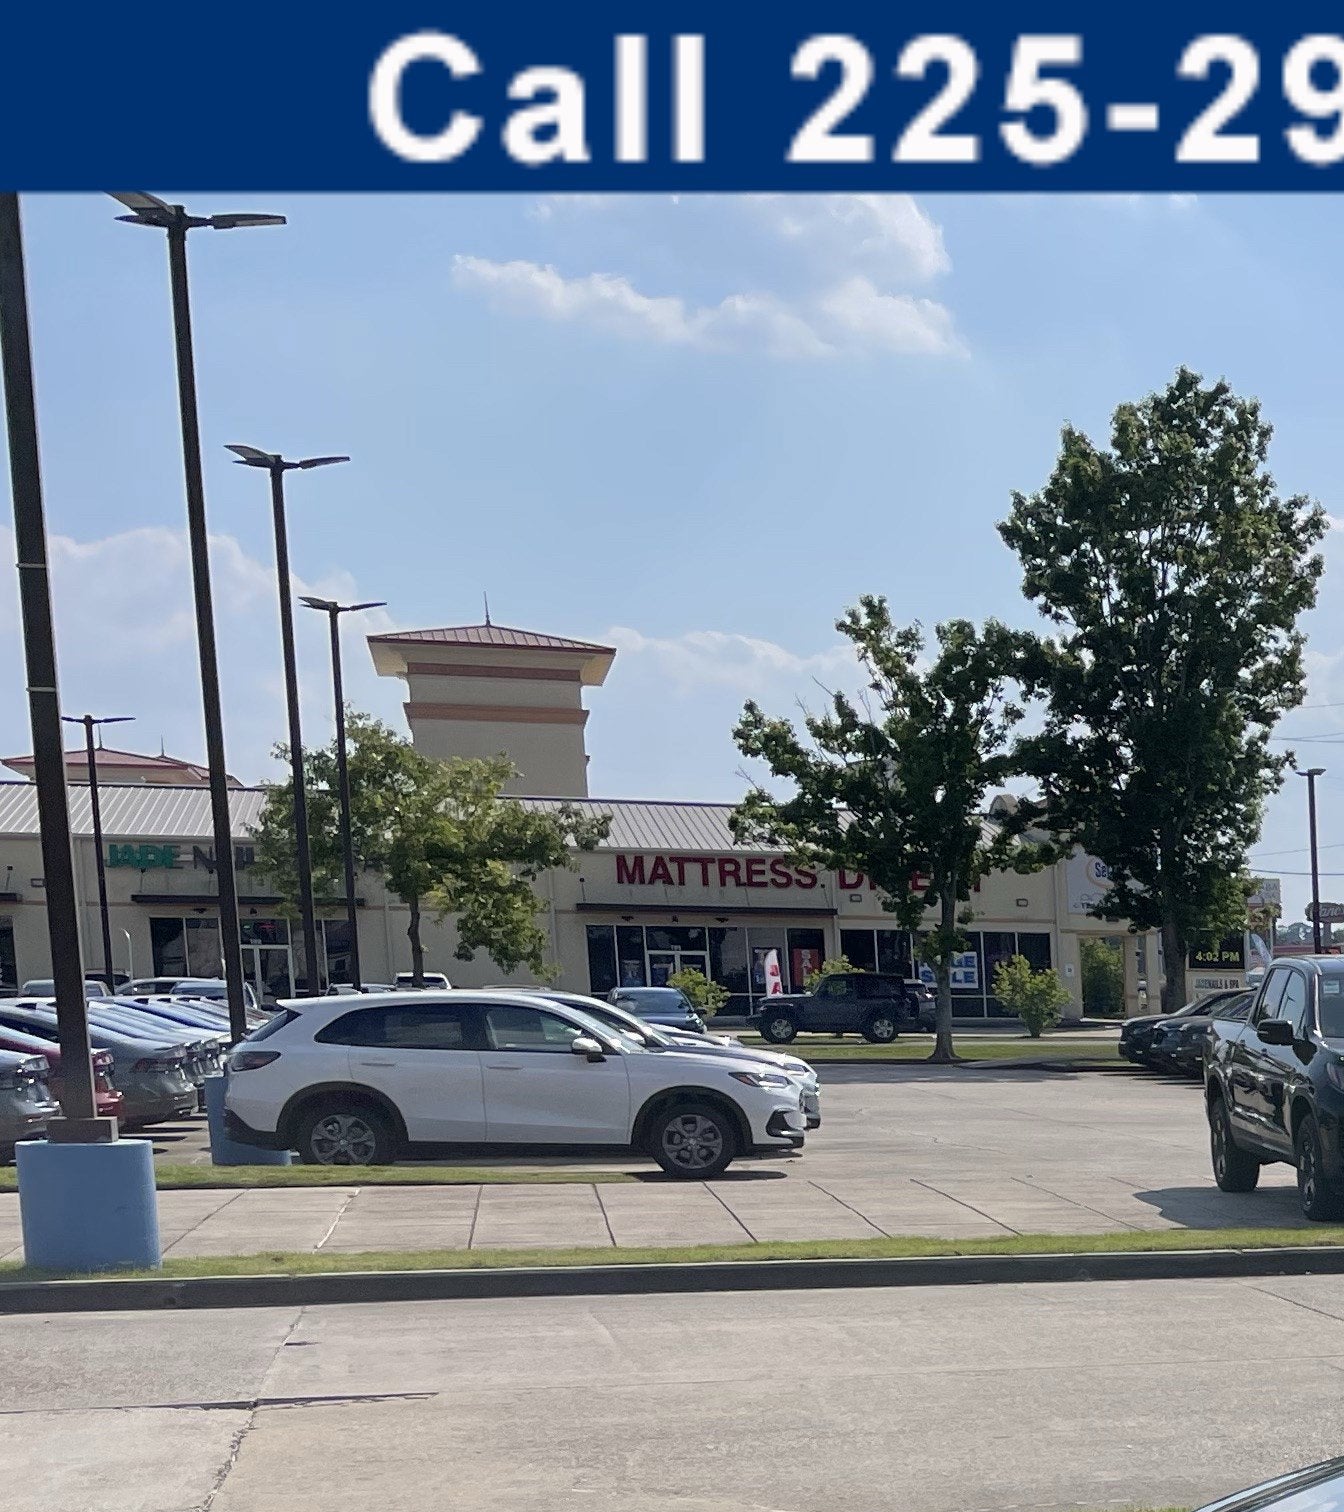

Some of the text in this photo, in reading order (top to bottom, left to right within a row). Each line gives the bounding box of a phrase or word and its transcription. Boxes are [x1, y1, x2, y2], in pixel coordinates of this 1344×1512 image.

[616, 854, 818, 889] MATTRESS
[1222, 951, 1241, 962] PM
[920, 970, 977, 983] SLE
